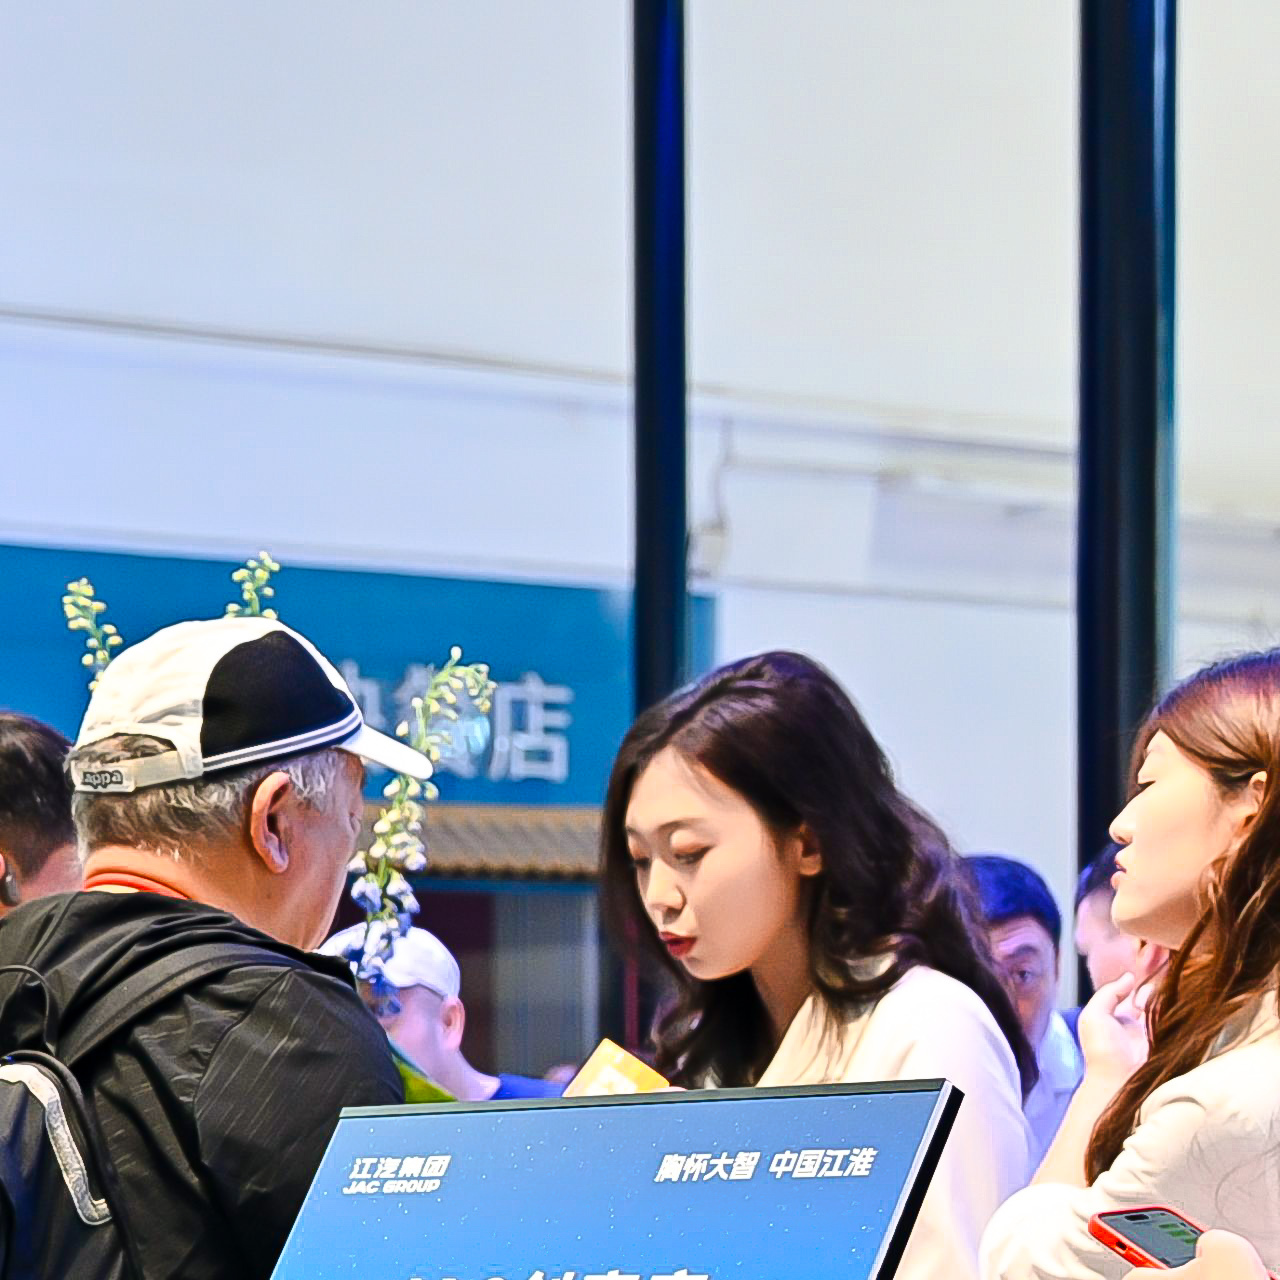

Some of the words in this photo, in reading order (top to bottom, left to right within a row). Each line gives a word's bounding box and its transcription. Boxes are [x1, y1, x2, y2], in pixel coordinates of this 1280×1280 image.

[349, 1154, 452, 1179] 江汽集团
[653, 1151, 761, 1182] 胸怀大智
[768, 1147, 878, 1179] 中国江淮
[342, 1180, 381, 1195] JAC
[382, 1179, 441, 1194] GROUP
